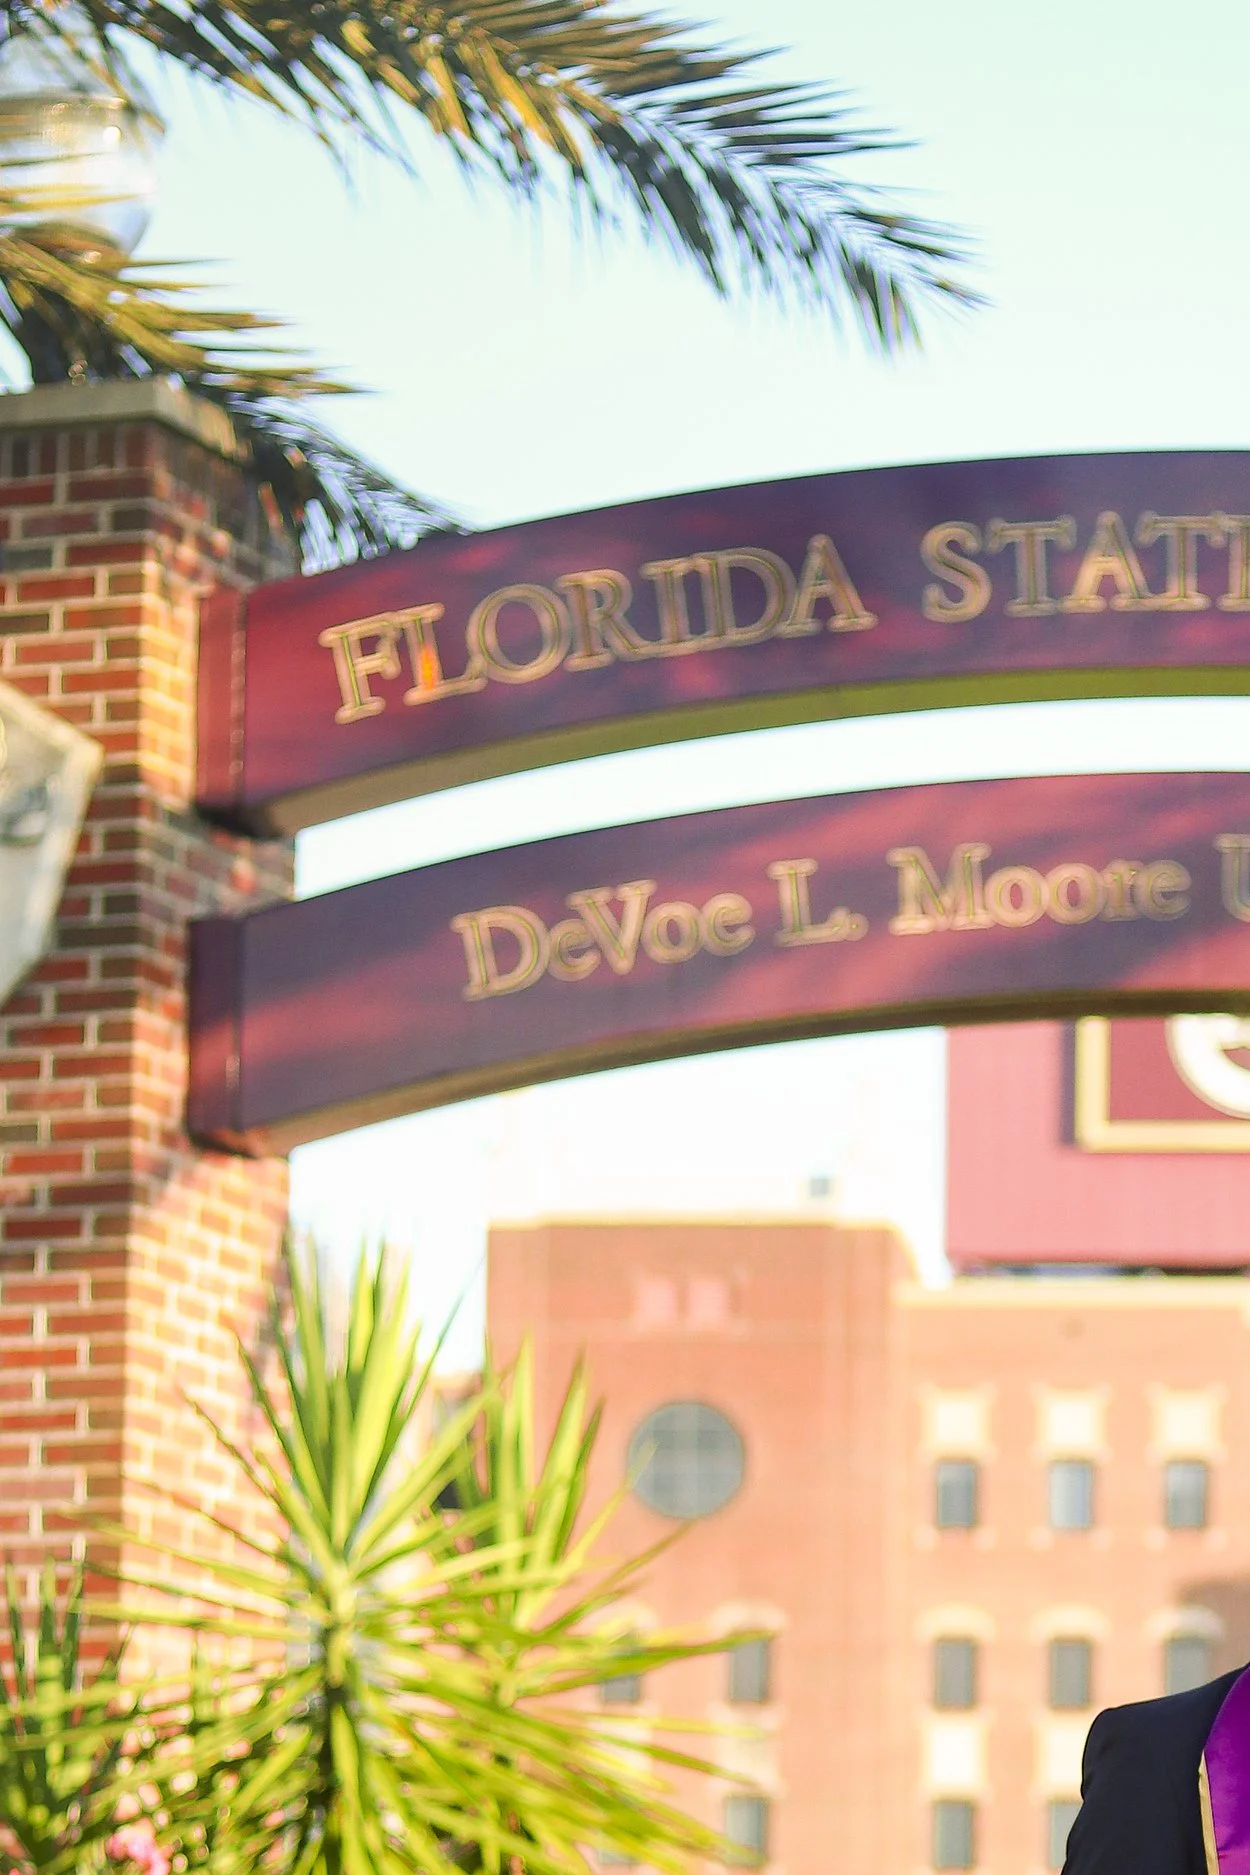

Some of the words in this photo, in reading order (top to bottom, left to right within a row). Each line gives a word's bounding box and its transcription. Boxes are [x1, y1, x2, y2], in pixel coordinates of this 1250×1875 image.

[319, 534, 878, 725] FLORIDA
[450, 878, 755, 1000] DeVoe
[768, 858, 869, 948] L.
[885, 842, 1193, 937] Moore
